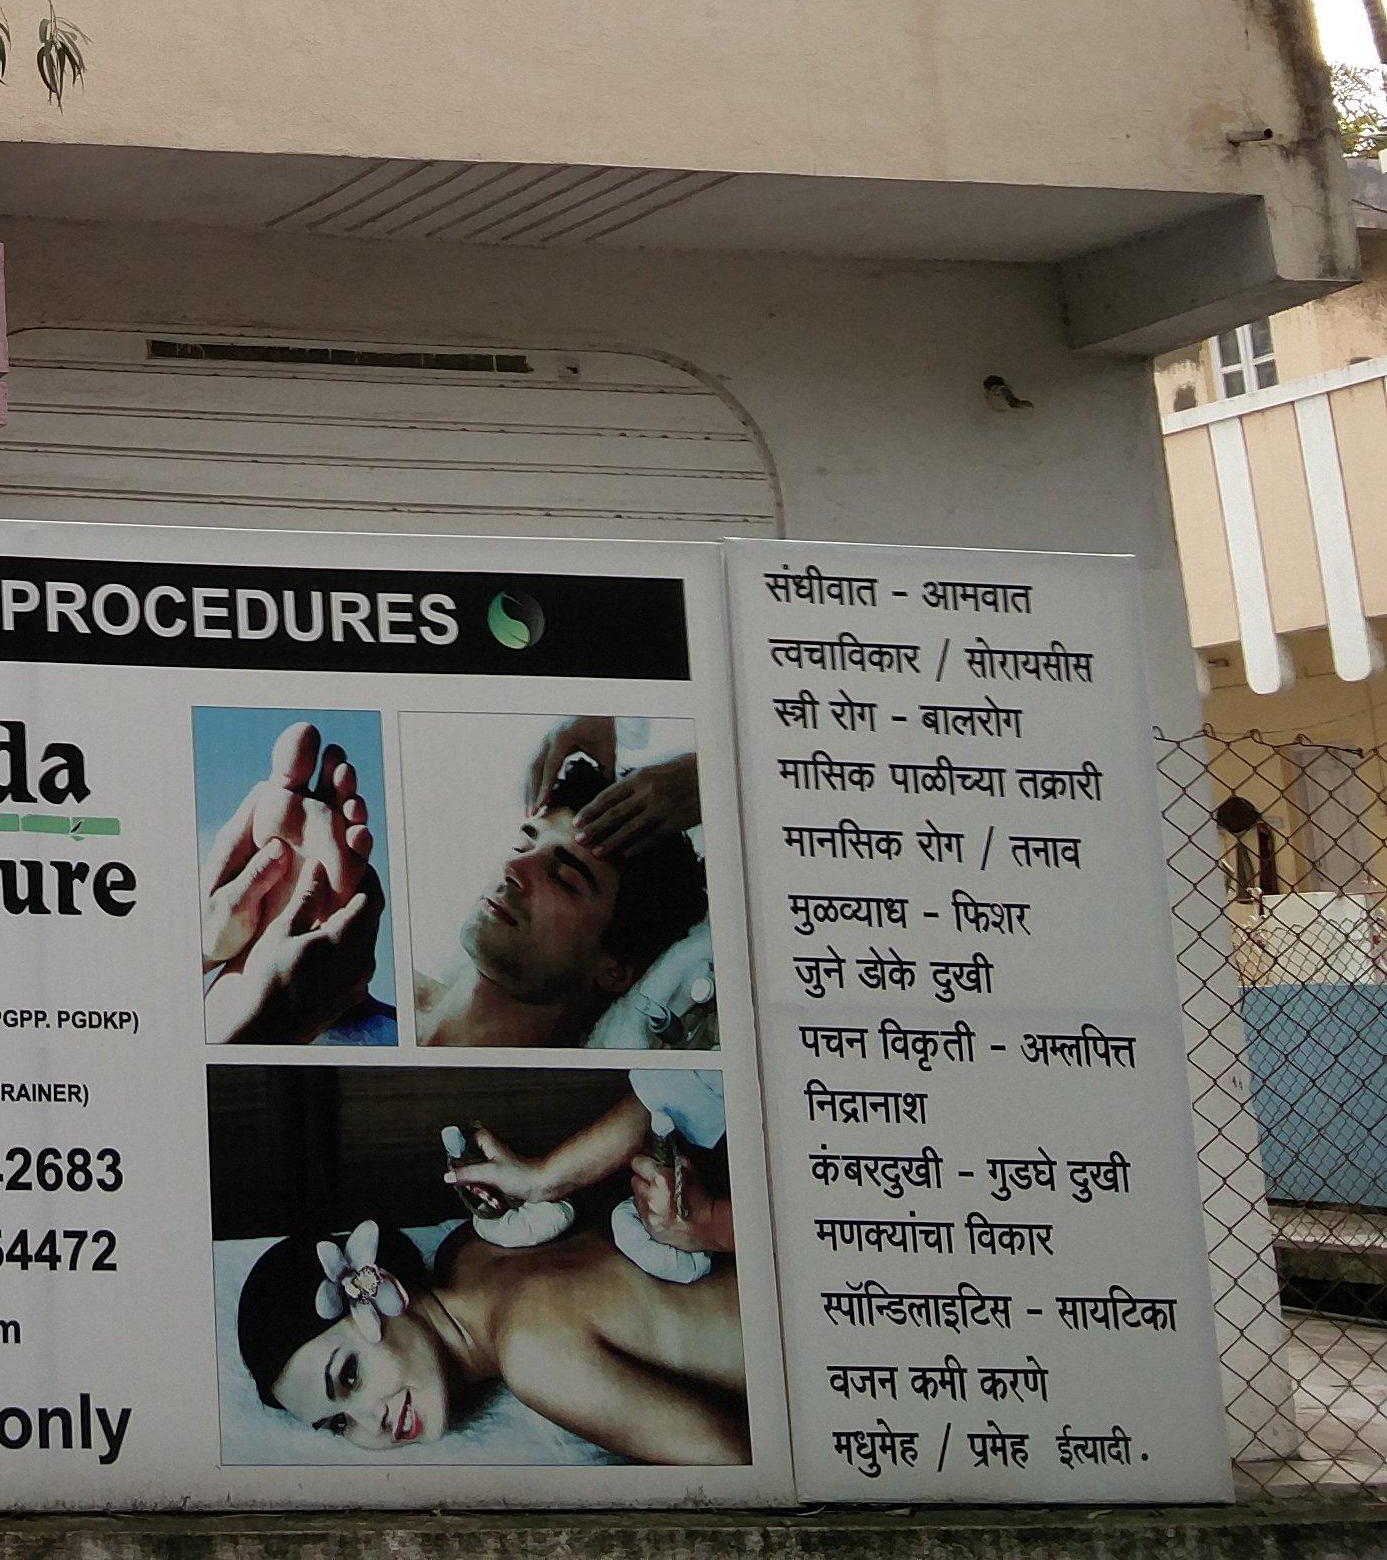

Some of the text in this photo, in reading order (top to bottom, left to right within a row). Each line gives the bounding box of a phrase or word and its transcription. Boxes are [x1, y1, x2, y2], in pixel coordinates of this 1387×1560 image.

[1, 580, 458, 645] PROCEDURES
[764, 564, 878, 606] संधीवात
[922, 582, 1033, 613] आमवात
[769, 632, 920, 673] त्वचाविकार
[964, 637, 1094, 682] सोरायसीस
[828, 689, 877, 732] रोग
[919, 695, 1023, 738] बालरोग
[778, 750, 1103, 801] मासिक पाळीच्या तक्रारी
[782, 819, 903, 860] मानसिक
[916, 820, 964, 862] रोग
[1009, 836, 1081, 869] तनाव
[951, 889, 1030, 935] फिशर
[793, 945, 994, 1003] जुने डोके दुखी
[58, 1011, 138, 1034] PGDKP)
[799, 1026, 868, 1058] पचन
[804, 1079, 928, 1124] निद्रानाश
[986, 1147, 1057, 1201] गुडघे
[1067, 1151, 1131, 1203] दुखी
[965, 1212, 1053, 1255] विकार
[1055, 1285, 1177, 1332] सायटिका
[827, 1354, 1048, 1402] वजन कमी करणे
[832, 1418, 919, 1478] मधुमेह
[967, 1420, 1029, 1469] प्रमेह
